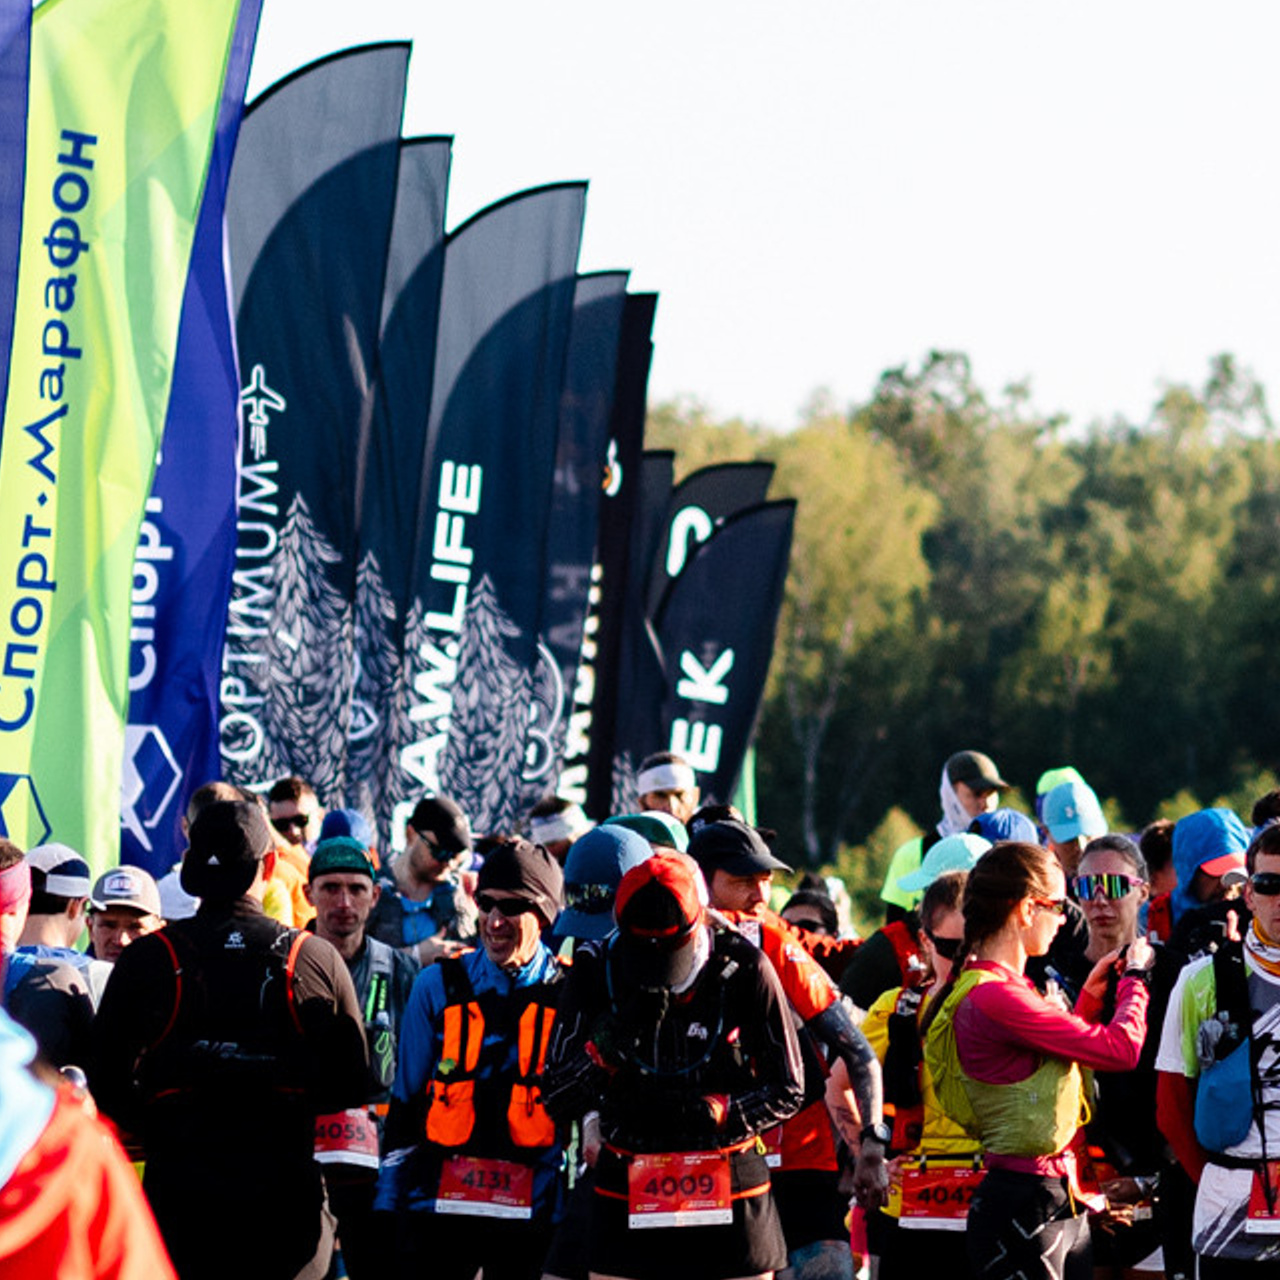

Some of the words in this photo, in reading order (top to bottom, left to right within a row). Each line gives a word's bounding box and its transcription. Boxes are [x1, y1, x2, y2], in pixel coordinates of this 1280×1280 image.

[218, 460, 280, 762] OPTIMUM
[461, 1170, 511, 1191] 4131
[644, 1174, 714, 1196] 4009
